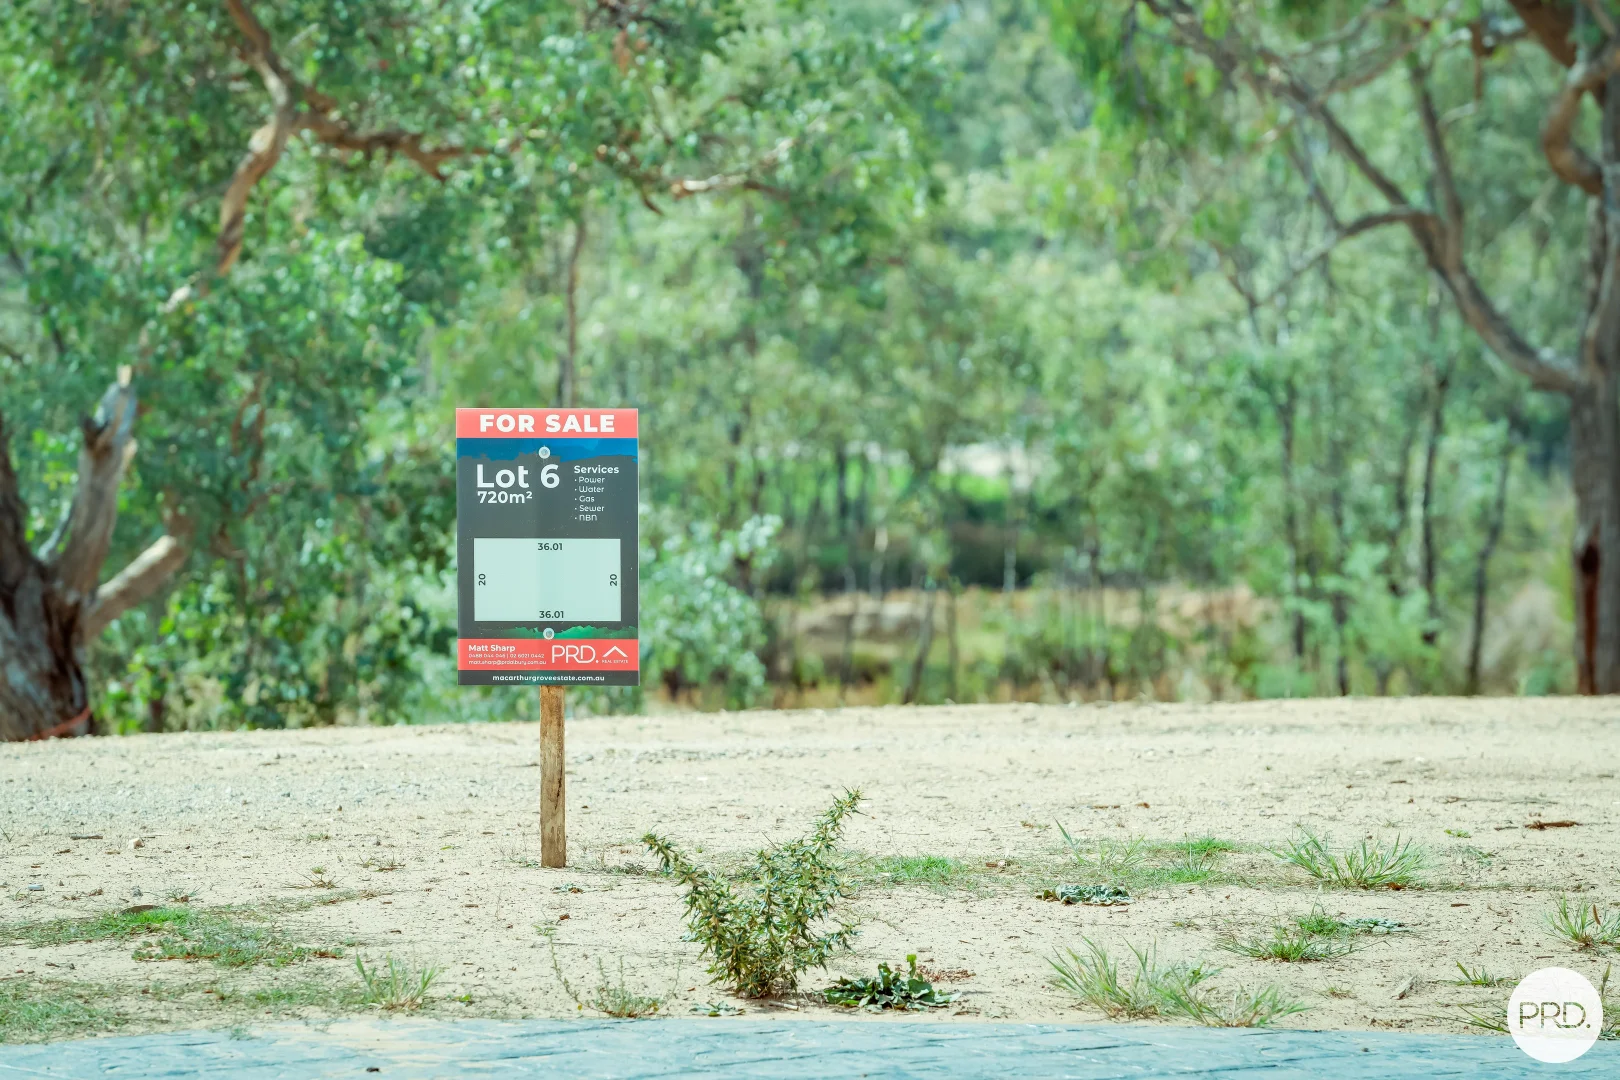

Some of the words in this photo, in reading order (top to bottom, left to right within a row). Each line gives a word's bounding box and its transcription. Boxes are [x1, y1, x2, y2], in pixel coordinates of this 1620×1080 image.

[479, 414, 535, 433] FOR
[545, 414, 615, 433] SALE
[573, 465, 620, 474] Services
[476, 464, 530, 488] Lot
[540, 464, 560, 488] 6
[578, 485, 605, 493] Water
[579, 495, 595, 503] Gas
[579, 504, 605, 512] Sewer
[537, 542, 563, 551] 36.01
[478, 573, 487, 586] 20
[609, 573, 618, 586] 20
[539, 610, 564, 619] 36.01
[468, 644, 489, 652] Matt
[490, 644, 516, 653] Sharp
[492, 674, 605, 683] macarthurgroveestate.com.au
